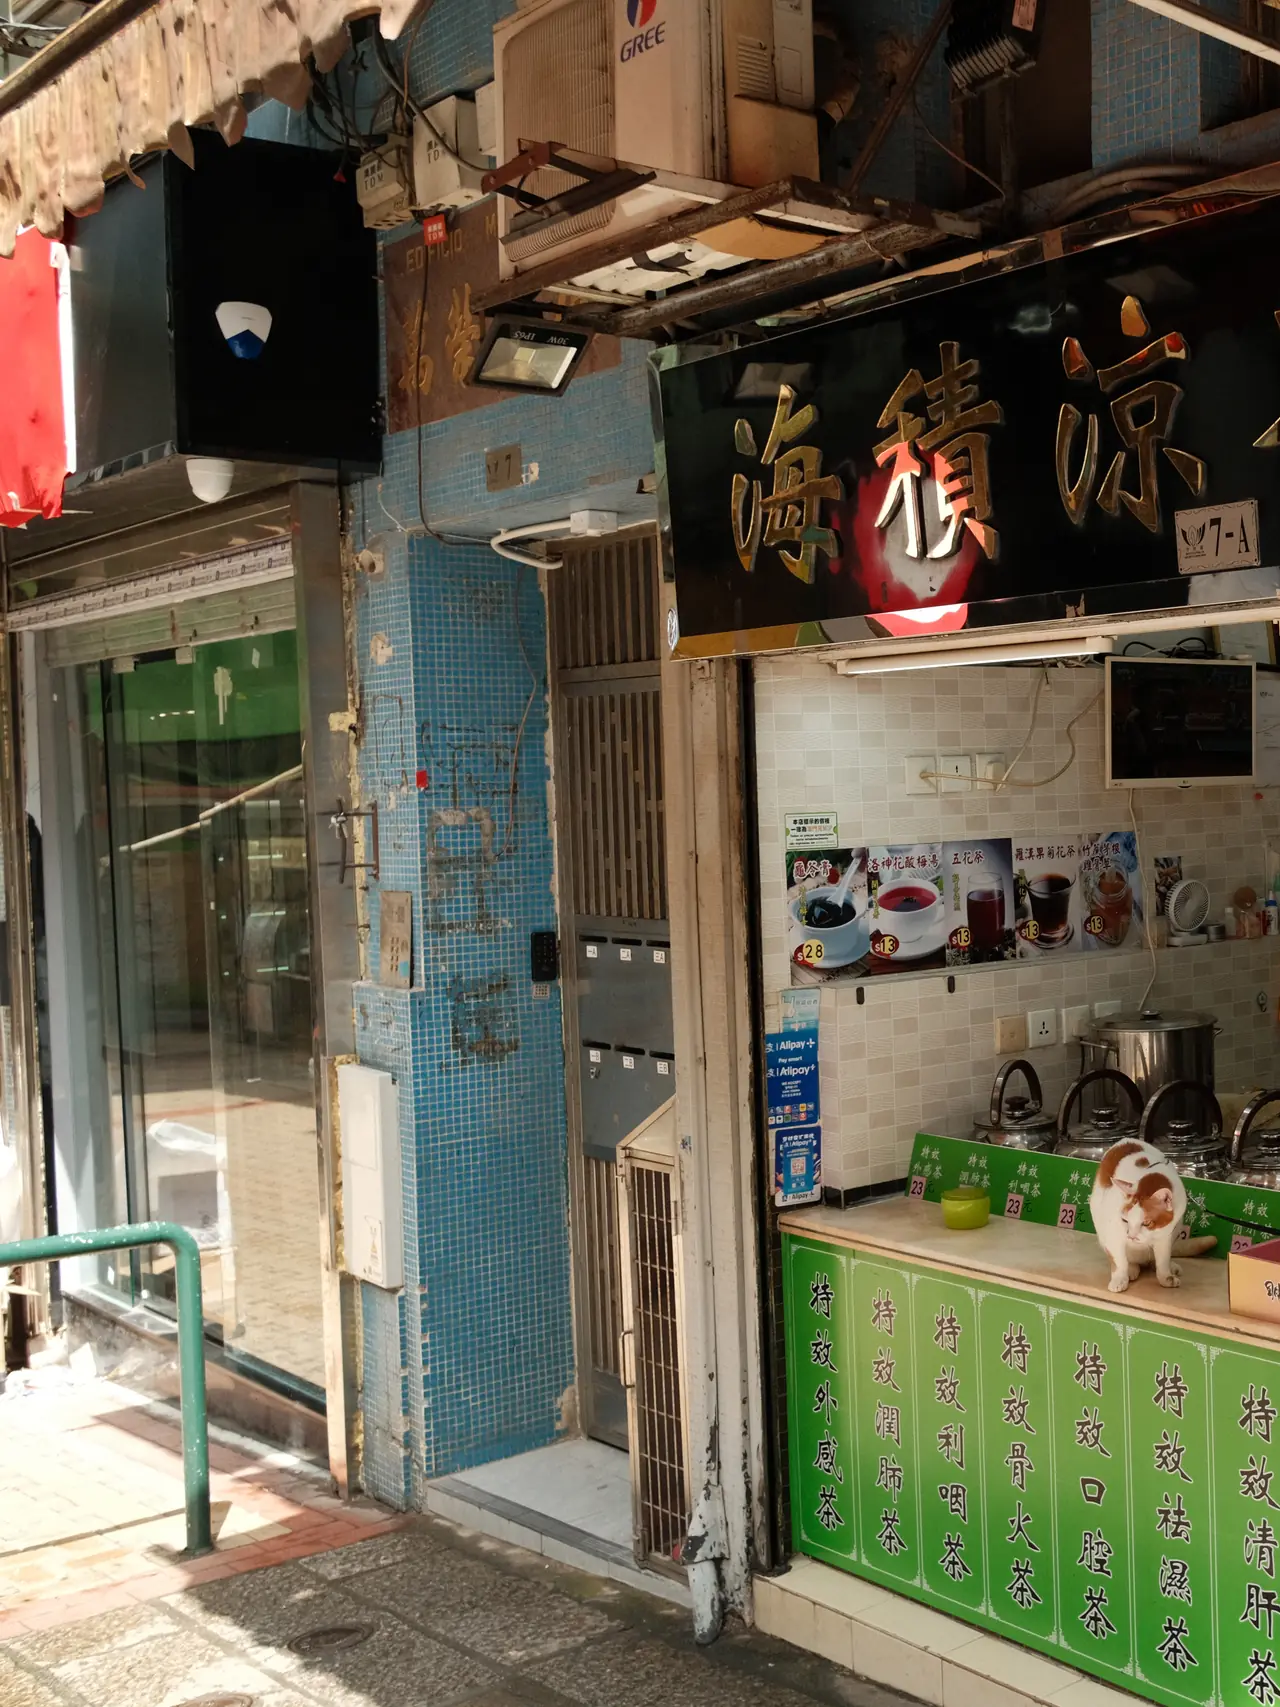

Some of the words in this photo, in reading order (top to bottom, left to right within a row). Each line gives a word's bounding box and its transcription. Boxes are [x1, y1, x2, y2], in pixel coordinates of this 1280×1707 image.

[620, 21, 666, 63] GREE
[1209, 514, 1251, 557] 7-A
[951, 852, 985, 865] 五花茶
[910, 1180, 924, 1195] 23
[1017, 1161, 1038, 1178] 特效
[1069, 1170, 1091, 1187] 特效
[1007, 1198, 1021, 1214] 23
[1060, 1208, 1074, 1224] 23
[1076, 1208, 1086, 1223] 元
[1242, 1198, 1269, 1218] 特效
[809, 1271, 845, 1531] 特效外感茶
[871, 1287, 908, 1556] 特效潤肺茶
[934, 1304, 973, 1581] 特效利咽茶
[1001, 1321, 1042, 1609] 特效骨火茶
[1074, 1340, 1118, 1639] 特效口腔茶
[1152, 1361, 1199, 1672] 特效祛濕茶
